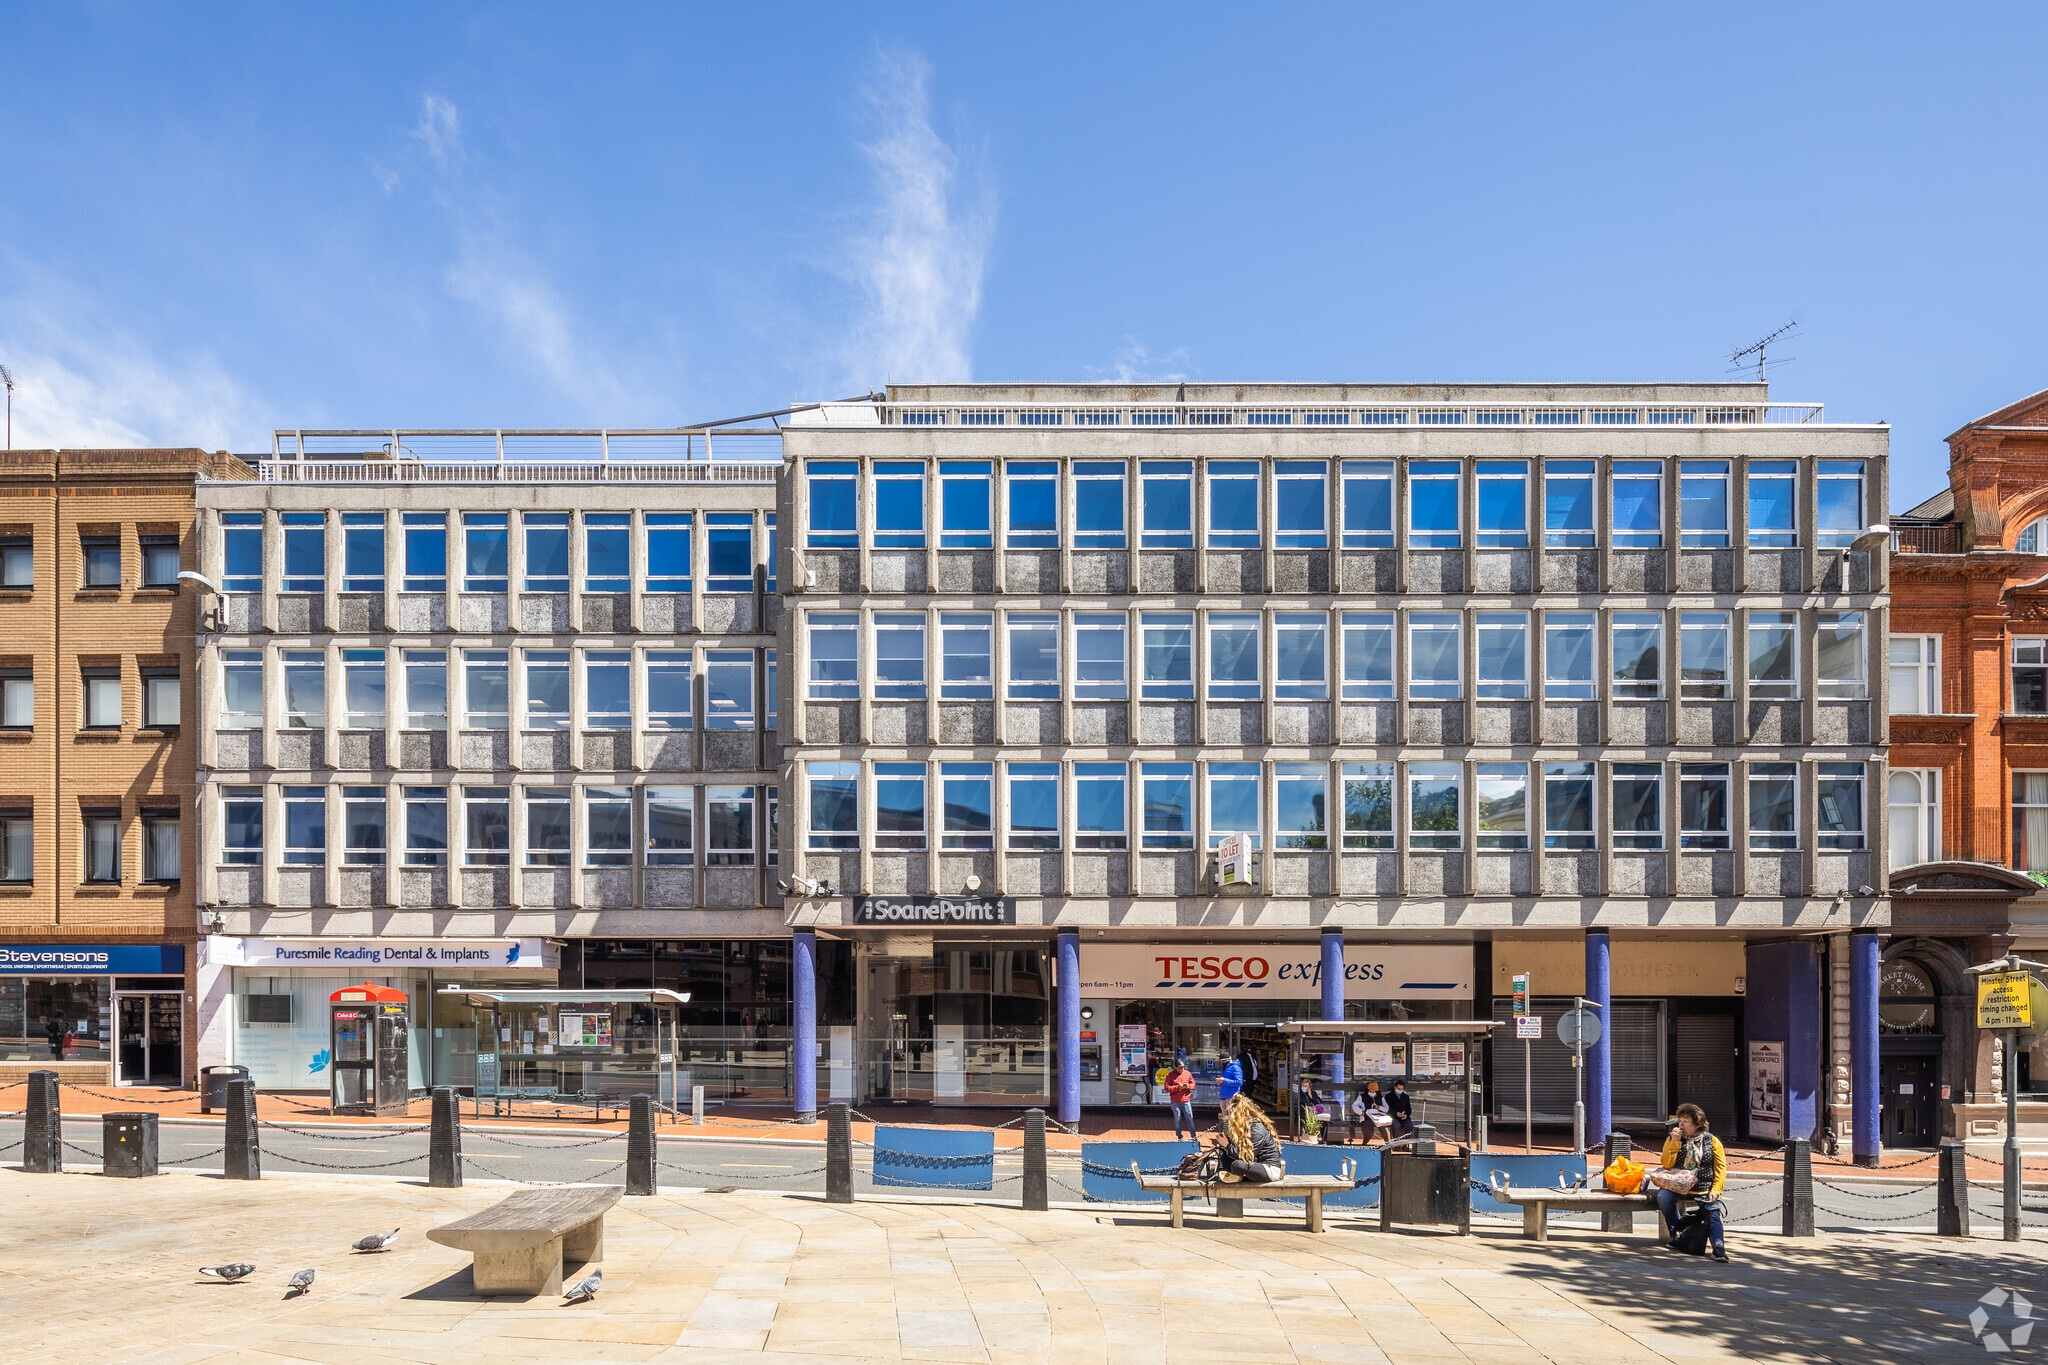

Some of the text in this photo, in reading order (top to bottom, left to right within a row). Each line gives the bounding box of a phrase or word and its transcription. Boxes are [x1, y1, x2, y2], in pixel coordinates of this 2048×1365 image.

[1221, 844, 1239, 859] TO LET
[875, 900, 994, 920] SoanePoint
[0, 950, 108, 962] Stevensons
[276, 947, 490, 963] Puresmile Reading Dental & Implants
[1154, 956, 1270, 980] TESCO
[1904, 972, 1926, 992] HOUSE
[1982, 974, 2026, 985] Minster Street
[1988, 996, 2020, 1004] restriction
[1980, 1003, 2028, 1013] timing changed
